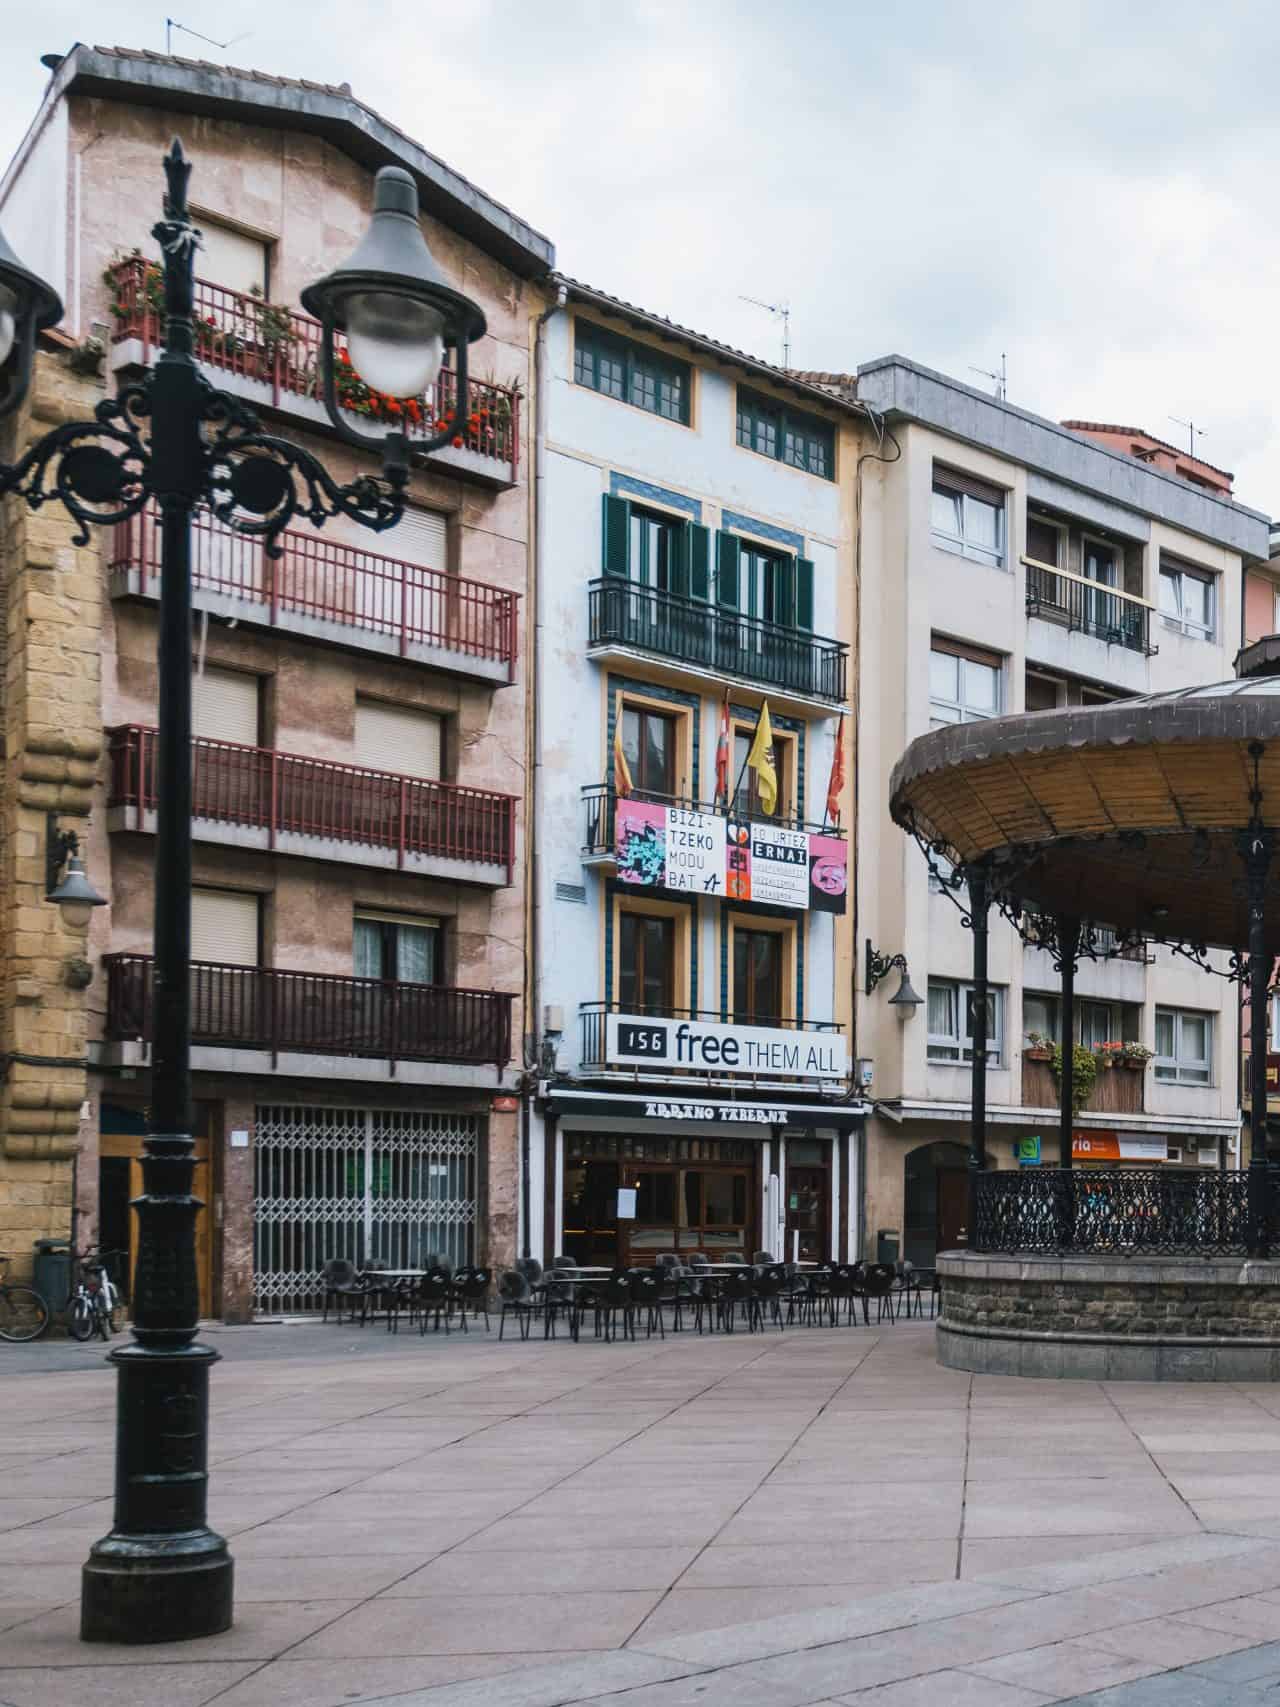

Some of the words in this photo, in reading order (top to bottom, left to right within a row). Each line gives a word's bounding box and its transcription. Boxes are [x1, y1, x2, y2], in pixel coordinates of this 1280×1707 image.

[670, 810, 712, 828] BIZI-
[670, 830, 713, 850] TZEKO
[773, 832, 806, 848] URTEZ
[669, 851, 705, 870] MODU
[755, 843, 806, 863] ERNAI
[669, 871, 696, 889] BAT
[628, 1031, 662, 1050] 156
[675, 1024, 739, 1066] free
[744, 1041, 799, 1070] THEM
[806, 1046, 839, 1073] ALL
[645, 1102, 714, 1120] ARRANO
[719, 1106, 788, 1124] TABERNA
